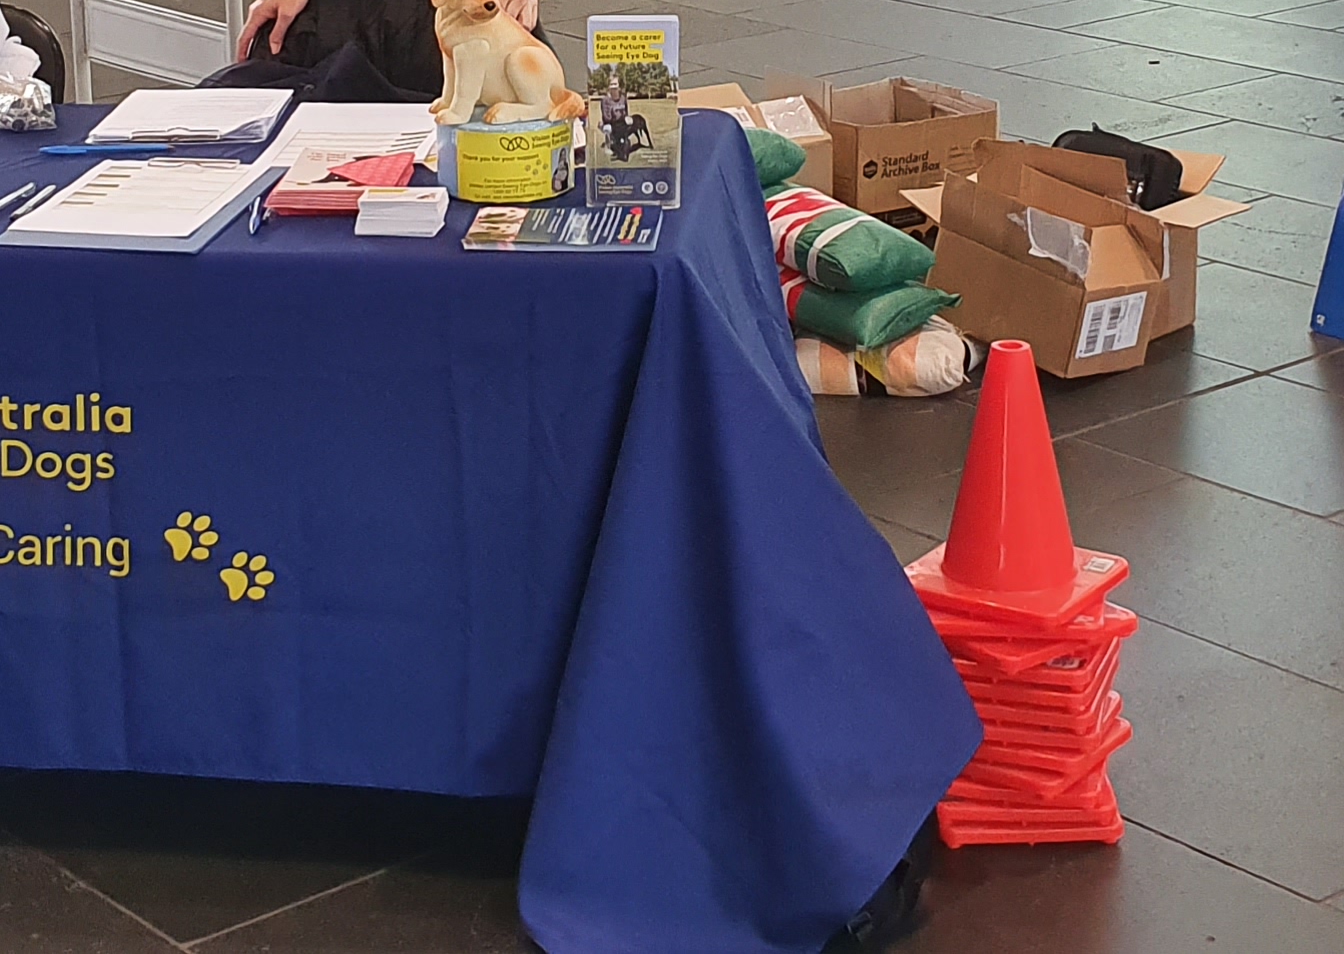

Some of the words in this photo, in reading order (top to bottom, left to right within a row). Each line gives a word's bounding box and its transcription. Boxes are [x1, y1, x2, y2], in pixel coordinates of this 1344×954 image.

[596, 34, 629, 42] Become
[596, 52, 624, 61] Seeing
[626, 52, 640, 61] Eye
[642, 51, 660, 60] Dog
[882, 150, 929, 167] Standard
[881, 164, 920, 179] Archive
[921, 161, 941, 173] Box
[0, 439, 115, 492] Dogs
